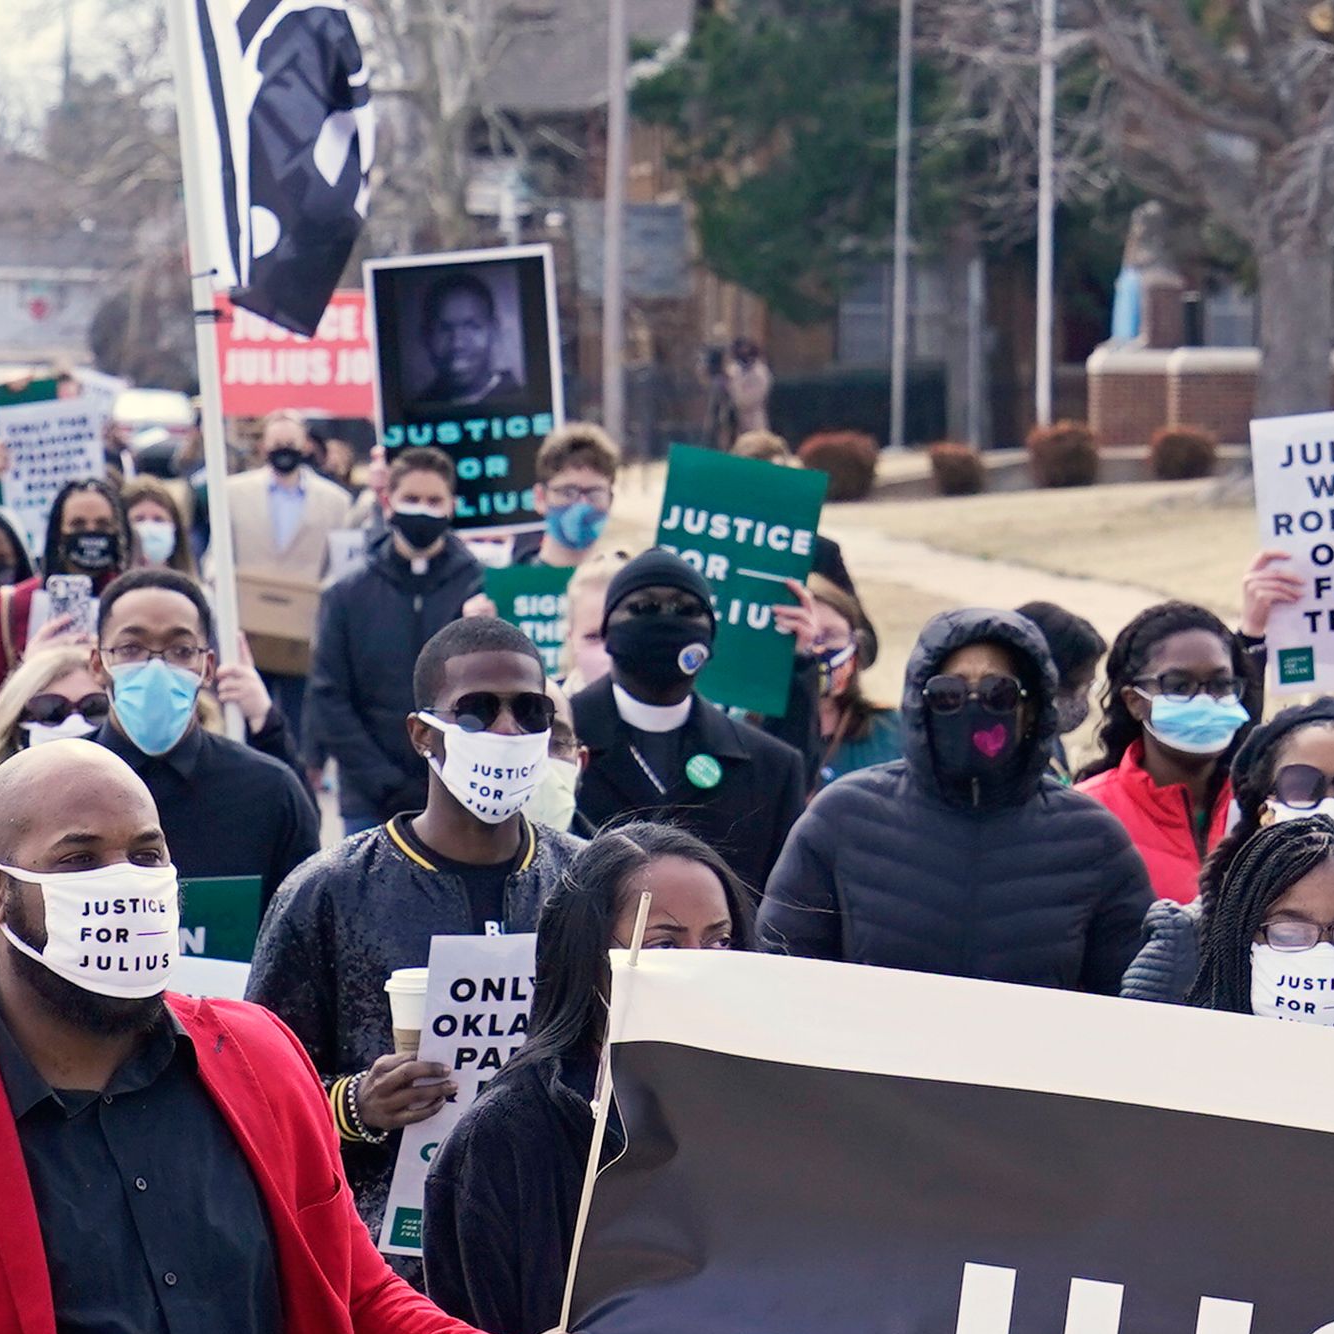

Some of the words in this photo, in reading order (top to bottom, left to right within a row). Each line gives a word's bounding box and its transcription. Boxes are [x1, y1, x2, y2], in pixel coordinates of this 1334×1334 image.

[222, 347, 332, 386] JULIUS
[382, 412, 554, 448] JUSTICE
[456, 454, 510, 480] OR
[454, 488, 537, 518] LIUS
[661, 504, 814, 556] JUSTICE
[82, 898, 167, 918] JUSTICE
[80, 927, 130, 945] FOR
[79, 952, 171, 973] JULIUS
[1275, 996, 1317, 1014] FOR
